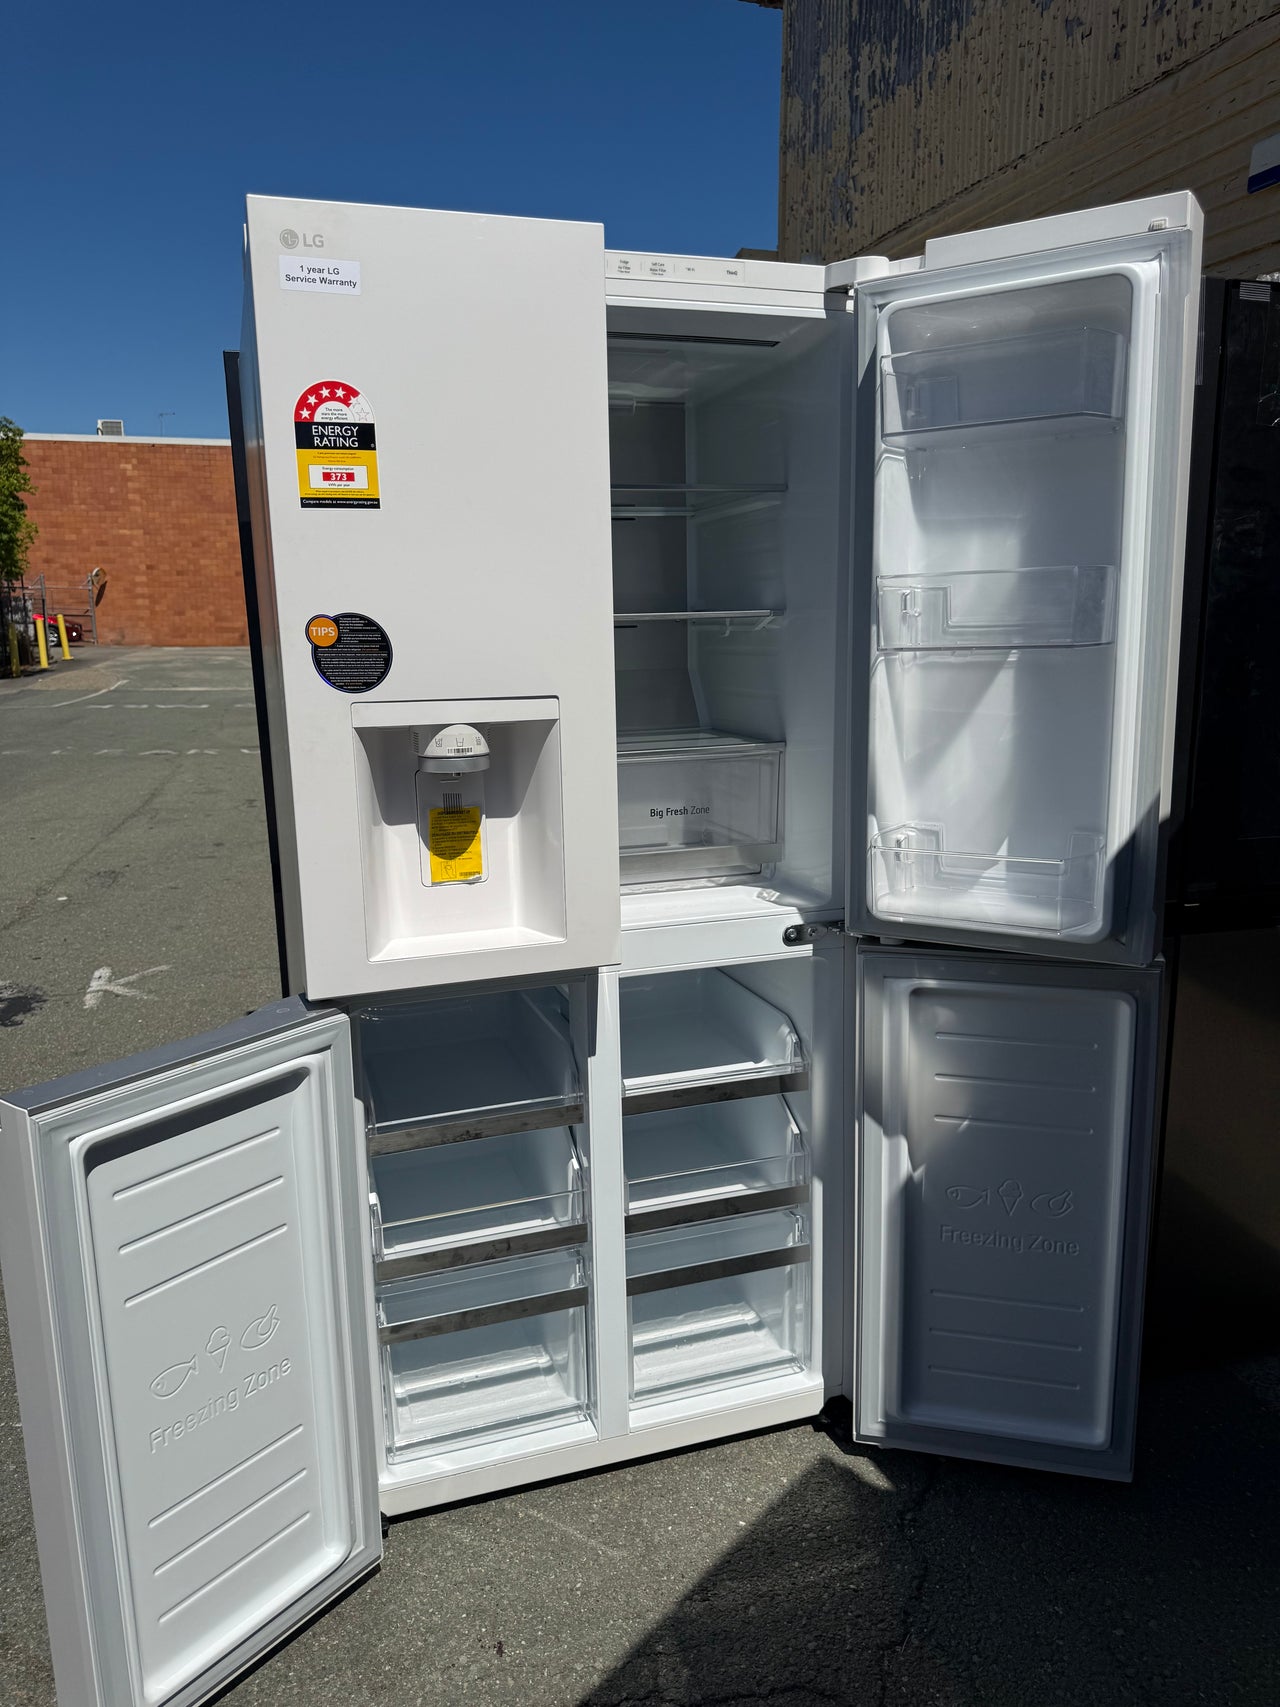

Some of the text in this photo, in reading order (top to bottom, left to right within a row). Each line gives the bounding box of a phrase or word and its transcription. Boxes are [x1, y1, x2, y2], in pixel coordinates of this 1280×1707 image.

[303, 233, 324, 248] LG
[299, 265, 340, 276] 1 year LG
[285, 273, 357, 289] Service Warranty
[312, 425, 359, 436] ENERGY
[314, 436, 359, 448] RATING
[330, 473, 347, 481] 373
[311, 627, 335, 637] TIPS
[650, 805, 710, 819] Big Fresh Zone
[940, 1225, 1080, 1256] Freezing Zone
[149, 1357, 292, 1454] Freezing Zone
